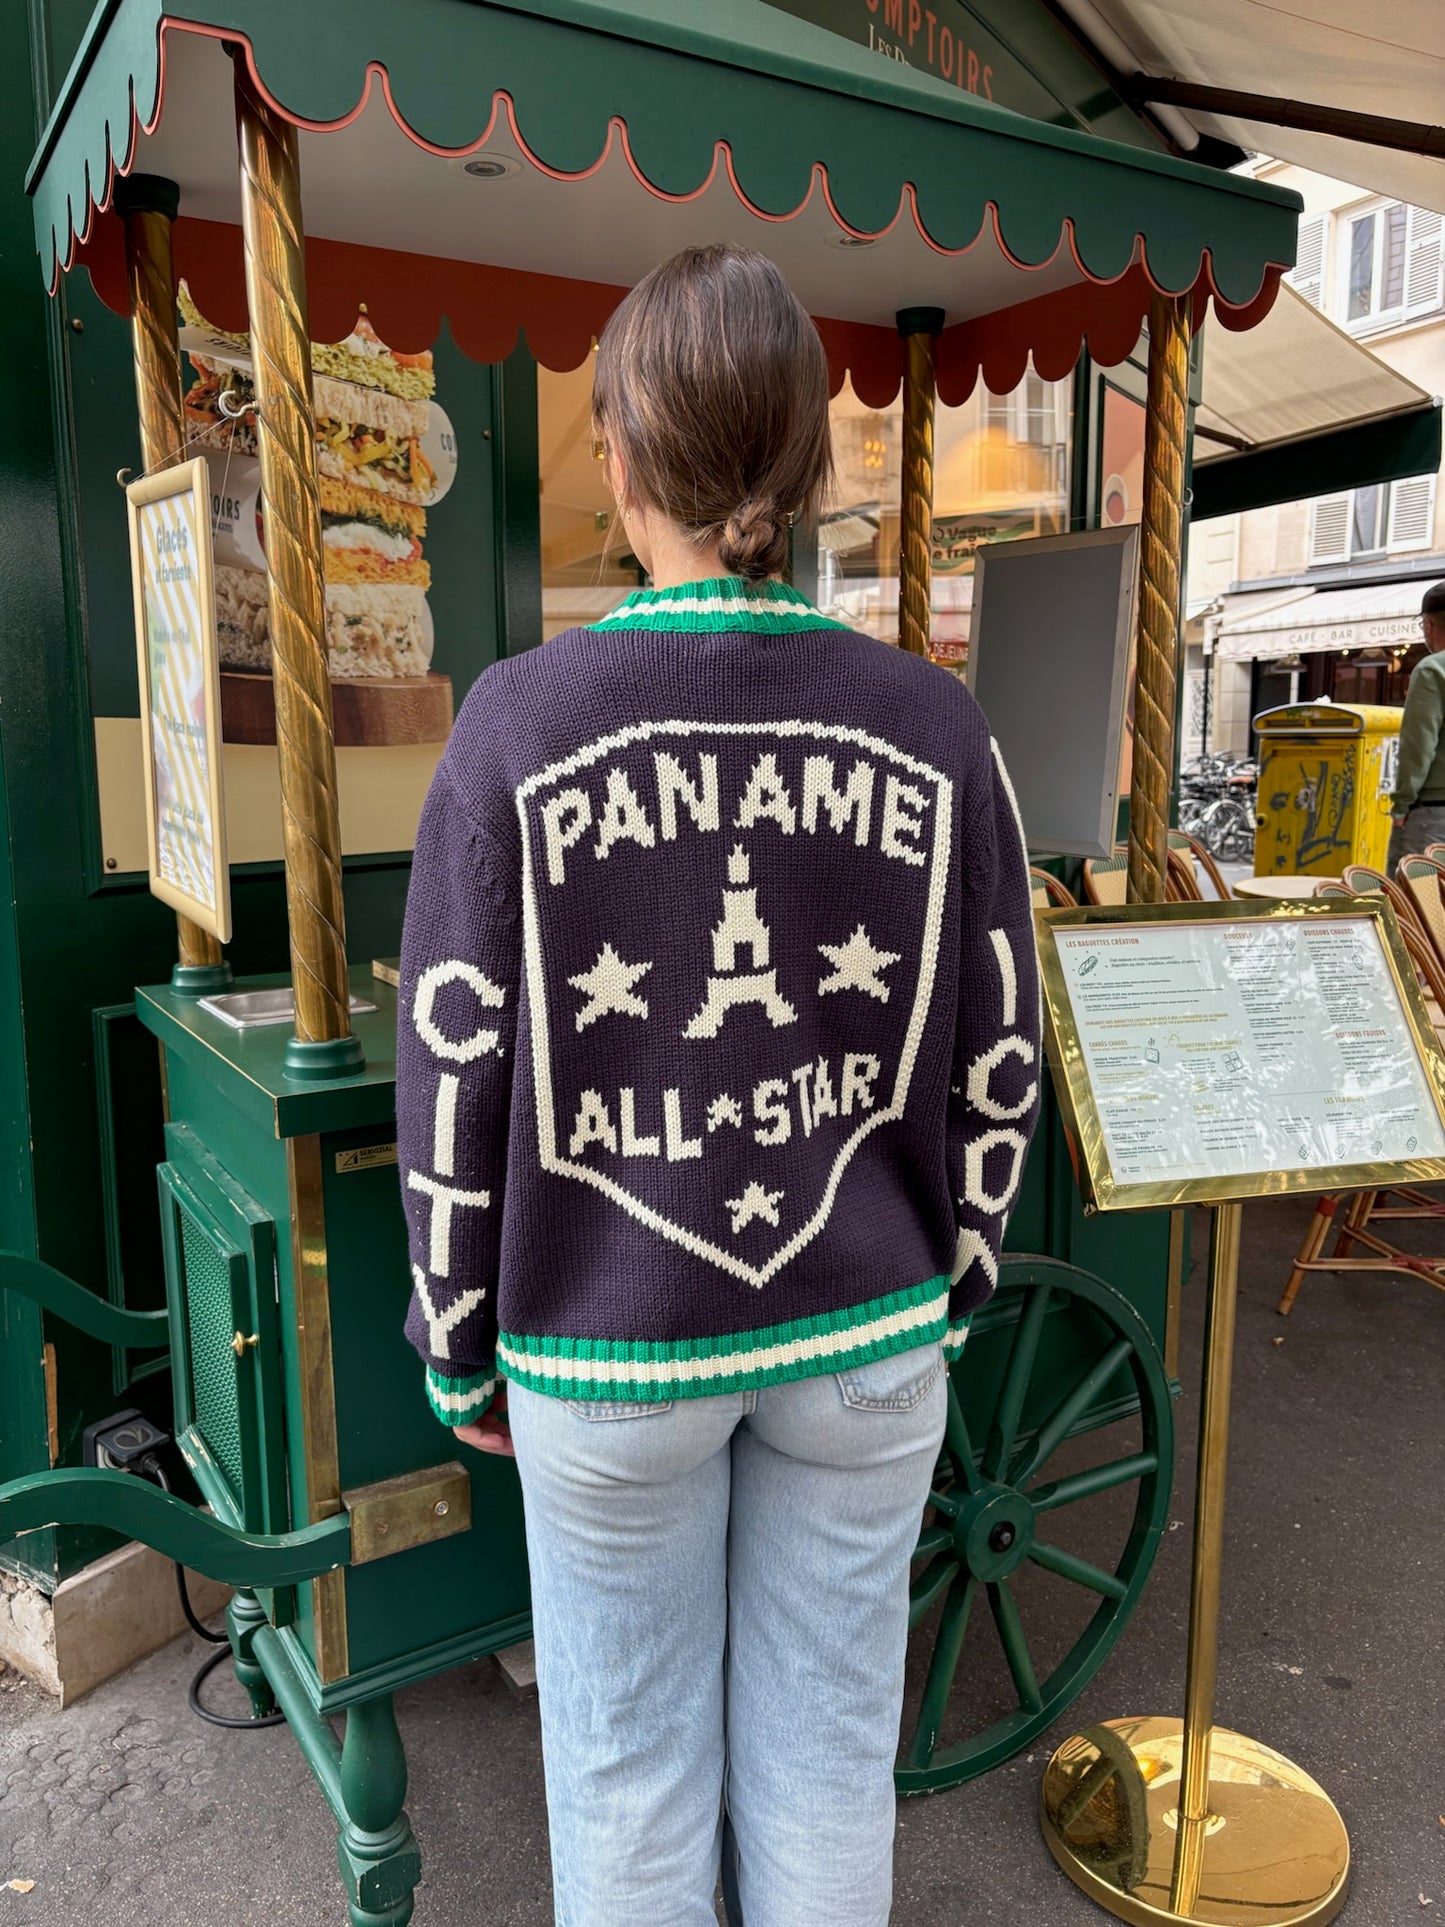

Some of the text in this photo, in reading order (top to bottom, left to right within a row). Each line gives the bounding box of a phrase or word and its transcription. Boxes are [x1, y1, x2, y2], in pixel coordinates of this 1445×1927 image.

[866, 0, 993, 103] MPTOIRS
[1288, 630, 1316, 644] CAFÉ
[1330, 629, 1353, 641] BAR
[1369, 622, 1417, 637] CUISINE
[541, 752, 930, 886] PANAME
[1110, 937, 1139, 945] CRÉATION
[407, 959, 506, 1361] CITY
[570, 1053, 882, 1163] ALL STAR
